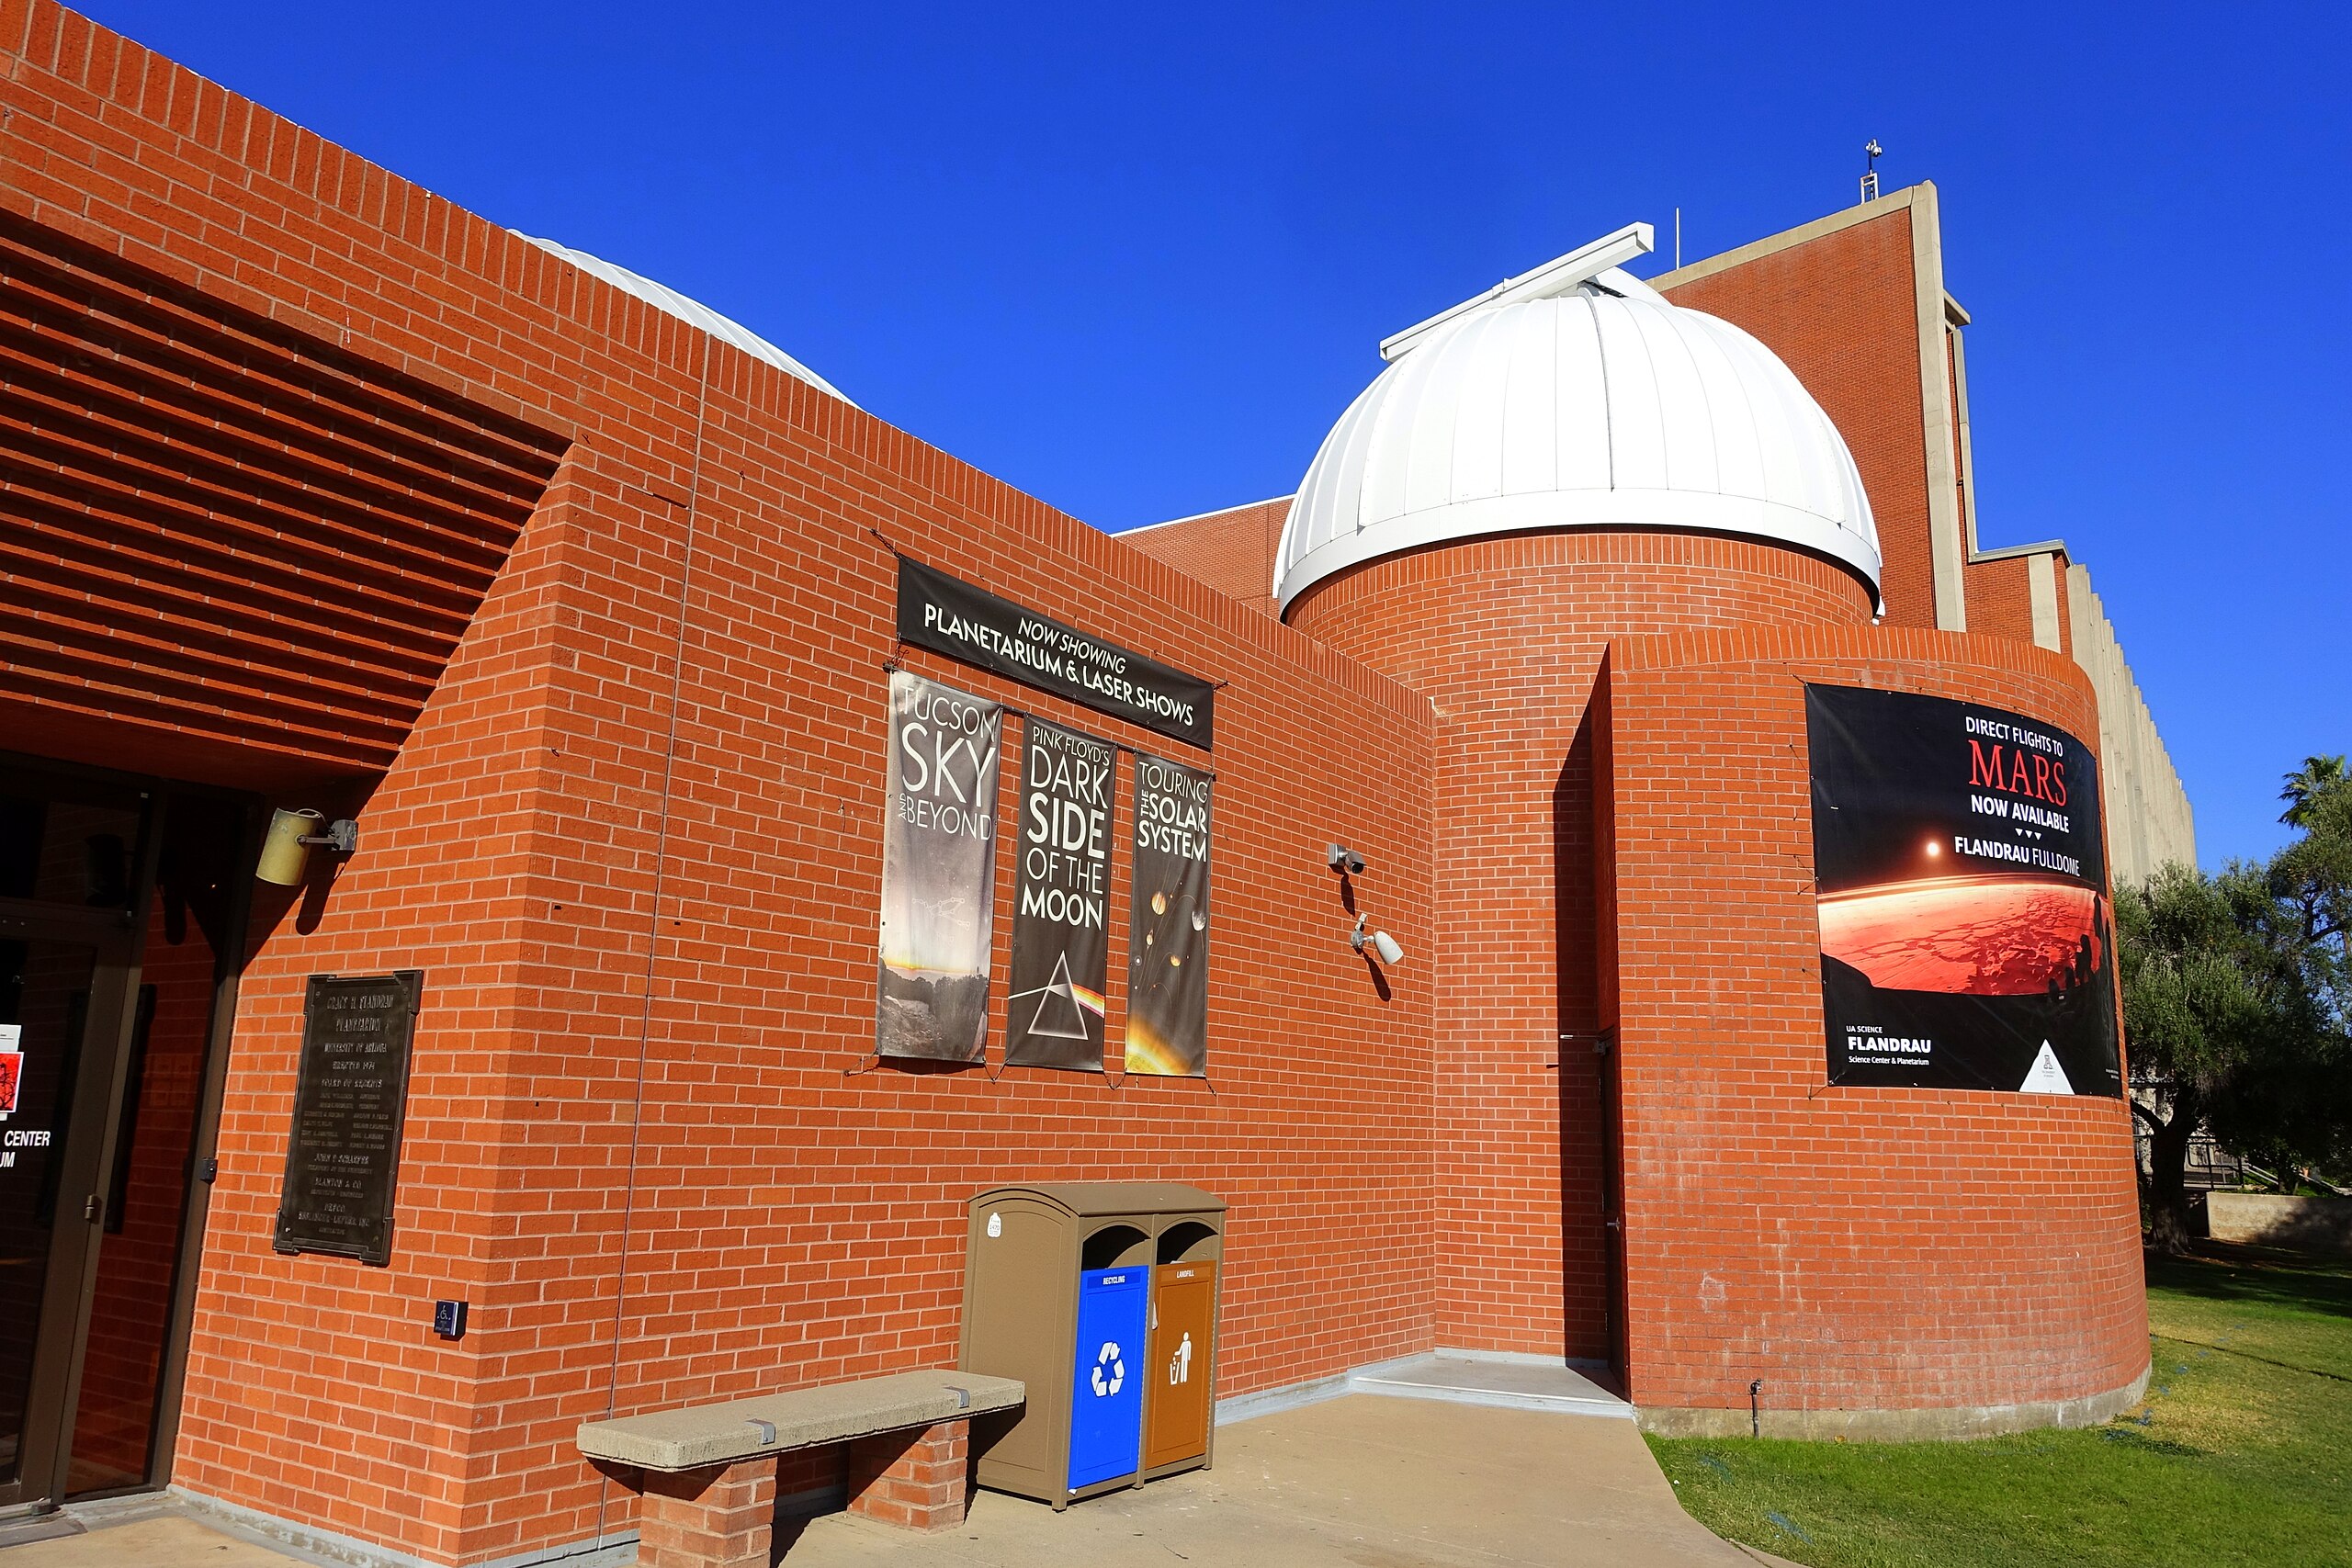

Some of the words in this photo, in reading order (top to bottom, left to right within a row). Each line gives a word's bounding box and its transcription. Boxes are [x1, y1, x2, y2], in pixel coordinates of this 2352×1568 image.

[923, 603, 1063, 678] PLANETARIUM
[1066, 660, 1080, 684] &
[1082, 669, 1134, 705] LASER
[1136, 687, 1194, 727] SHOWS
[1018, 617, 1059, 648] NOW
[1058, 635, 1127, 674] SHOWING
[900, 685, 997, 743] TUCSON
[1033, 726, 1063, 751] PINK
[1065, 737, 1110, 767] FLOYD'S
[1965, 716, 2010, 739] DIRECT
[2012, 727, 2052, 753] FLIGHTS
[2052, 739, 2064, 757] TO
[901, 722, 997, 807] SKY
[1030, 744, 1110, 808] DARK
[1138, 761, 1208, 803] TOURING
[1968, 739, 2067, 807] MARS
[898, 793, 907, 820] AND
[906, 795, 992, 840] BEYOND
[1140, 789, 1149, 817] THE
[1148, 793, 1208, 834] SOLAR
[1971, 795, 2008, 818] NOW
[2011, 802, 2070, 833] AVAILABLE
[1026, 792, 1105, 860] SIDE
[1137, 819, 1207, 863] SYSTEM
[1026, 847, 1060, 883] OF
[1066, 855, 1103, 895] THE
[1954, 836, 2030, 863] FLANDRAU
[2031, 848, 2081, 877] FULLDOME
[1021, 883, 1103, 931] MOON
[1848, 1036, 1931, 1054] FLANDRAU
[1849, 1055, 1871, 1064] Science
[1871, 1056, 1891, 1065] Center
[1897, 1057, 1929, 1066] Planetarium
[4, 1130, 51, 1146] CENTER
[1102, 1275, 1125, 1285] RECYCLING
[1176, 1269, 1194, 1279] LANDFILL
